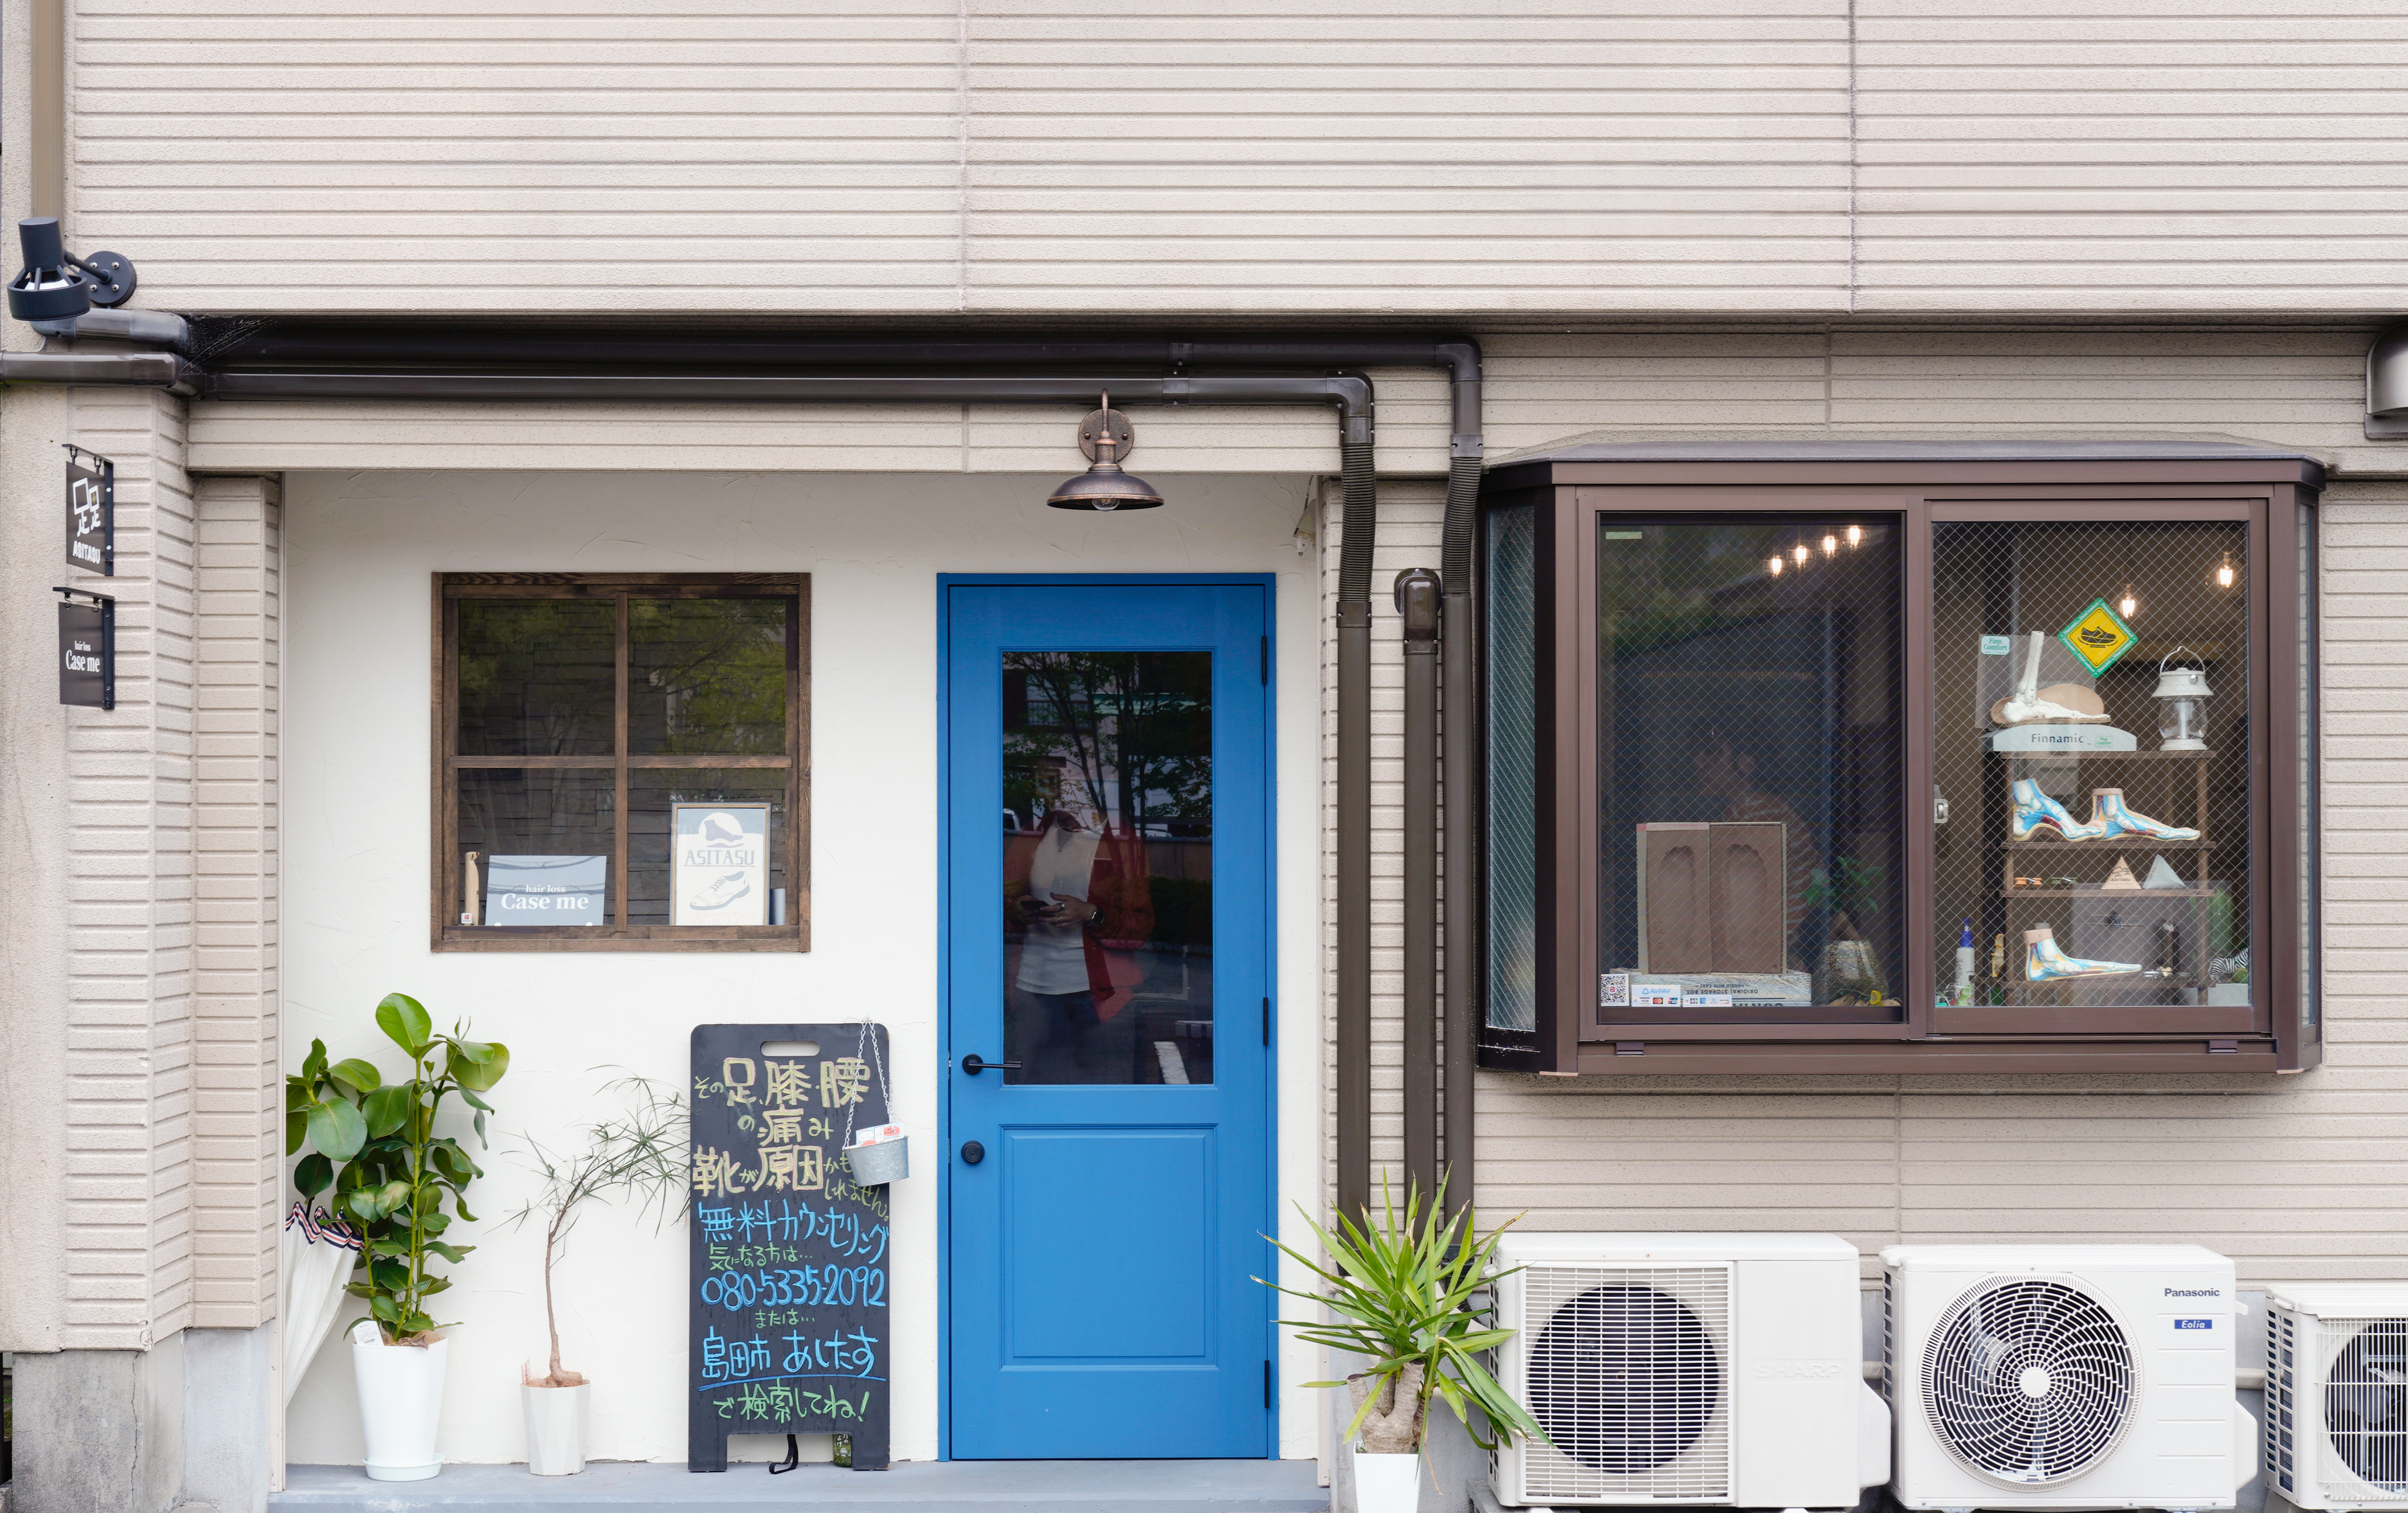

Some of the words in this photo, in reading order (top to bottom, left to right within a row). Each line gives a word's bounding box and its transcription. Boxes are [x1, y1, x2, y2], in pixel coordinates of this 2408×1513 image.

[72, 540, 101, 565] ASITASU
[66, 649, 86, 671] Case
[87, 657, 101, 673] me
[2031, 733, 2085, 743] Finnamic
[685, 850, 755, 865] ASITASU
[501, 893, 551, 910] Case
[555, 896, 589, 910] me
[737, 1104, 834, 1146] の痛み
[698, 1198, 890, 1264] 無料カウンセリング
[700, 1264, 886, 1311] 080-5335-2092
[2164, 1288, 2220, 1297] Panasonic
[2181, 1320, 2206, 1329] Eolia
[702, 1326, 771, 1381] 島田市
[783, 1326, 879, 1378] あしたす
[1754, 1363, 1844, 1378] SHARP
